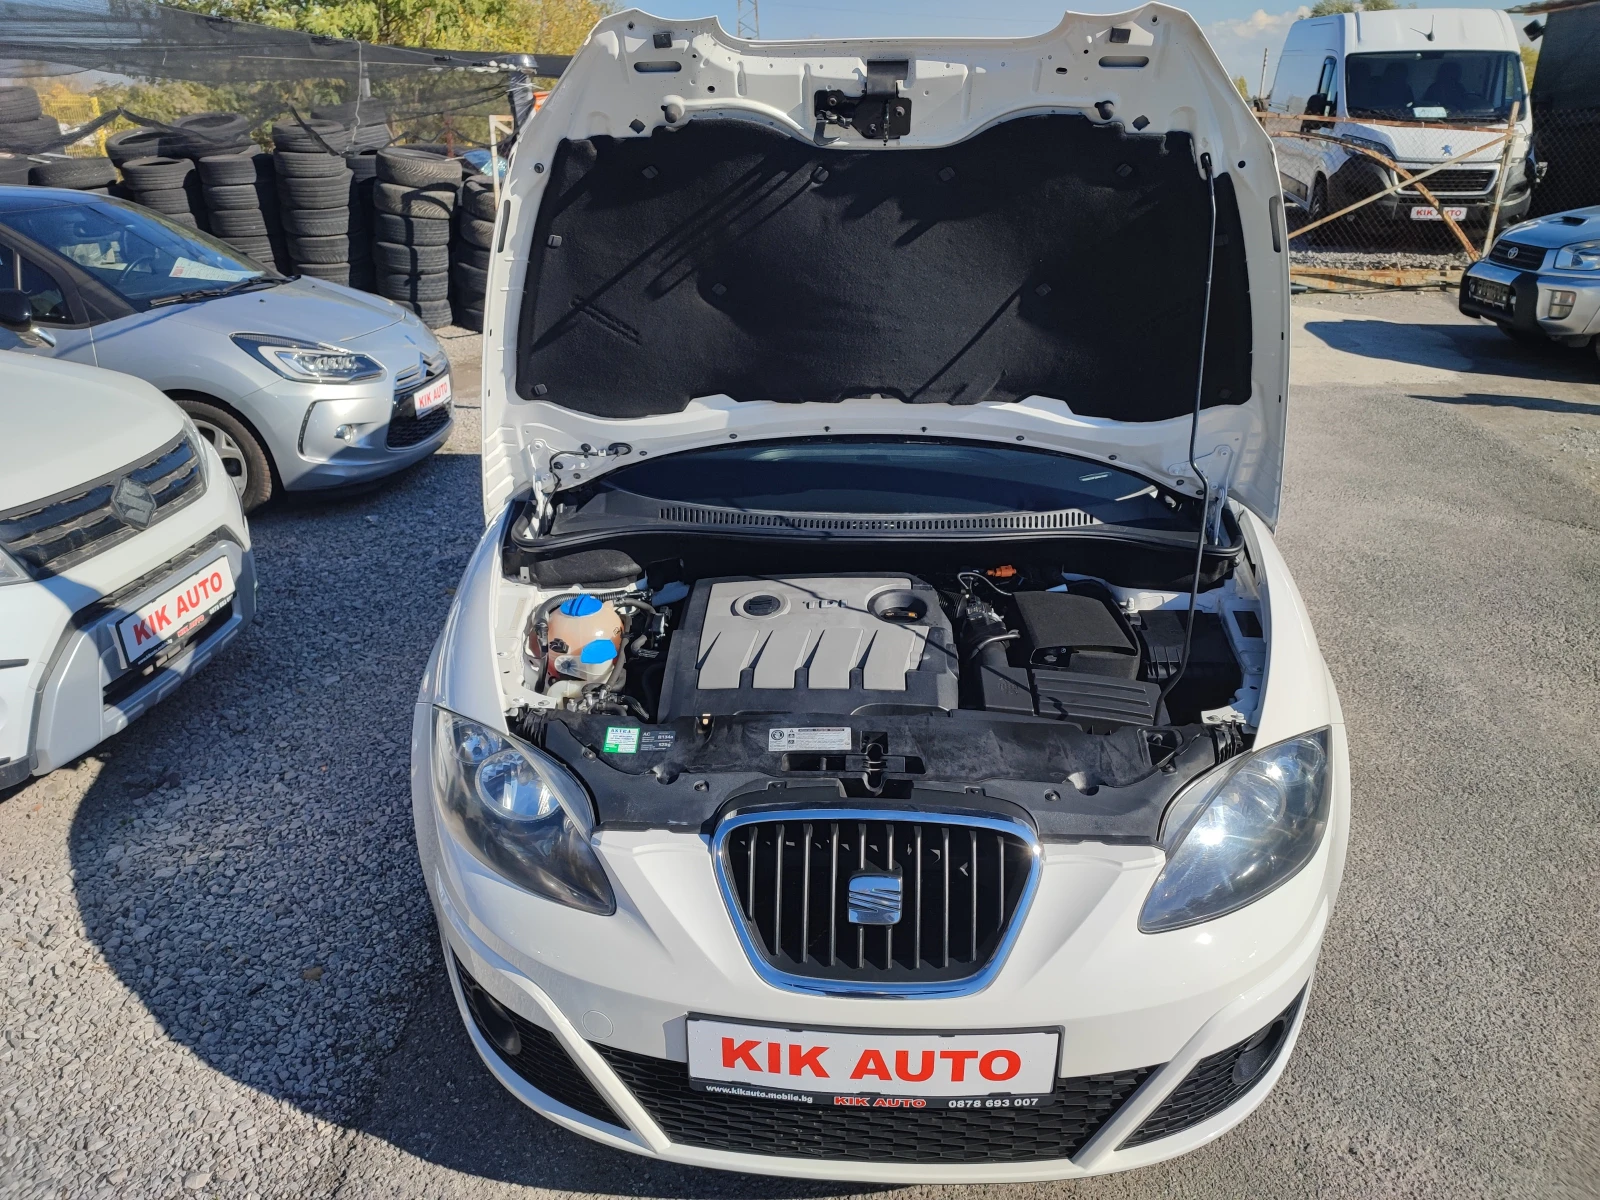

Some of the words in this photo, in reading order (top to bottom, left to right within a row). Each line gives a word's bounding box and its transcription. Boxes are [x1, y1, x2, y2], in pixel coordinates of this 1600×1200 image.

[418, 391, 432, 408] KIK
[433, 382, 448, 400] AUTO
[132, 604, 173, 646] KIK
[176, 571, 223, 619] AUTO
[721, 1036, 831, 1079] KIK
[850, 1049, 1022, 1082] AUTO
[705, 1085, 813, 1104] www.kikauto.mobile.bg
[834, 1096, 870, 1107] KIK
[873, 1098, 927, 1108] AUTO
[948, 1099, 982, 1108] 0878
[985, 1098, 1010, 1108] 693
[1014, 1097, 1039, 1107] 007
